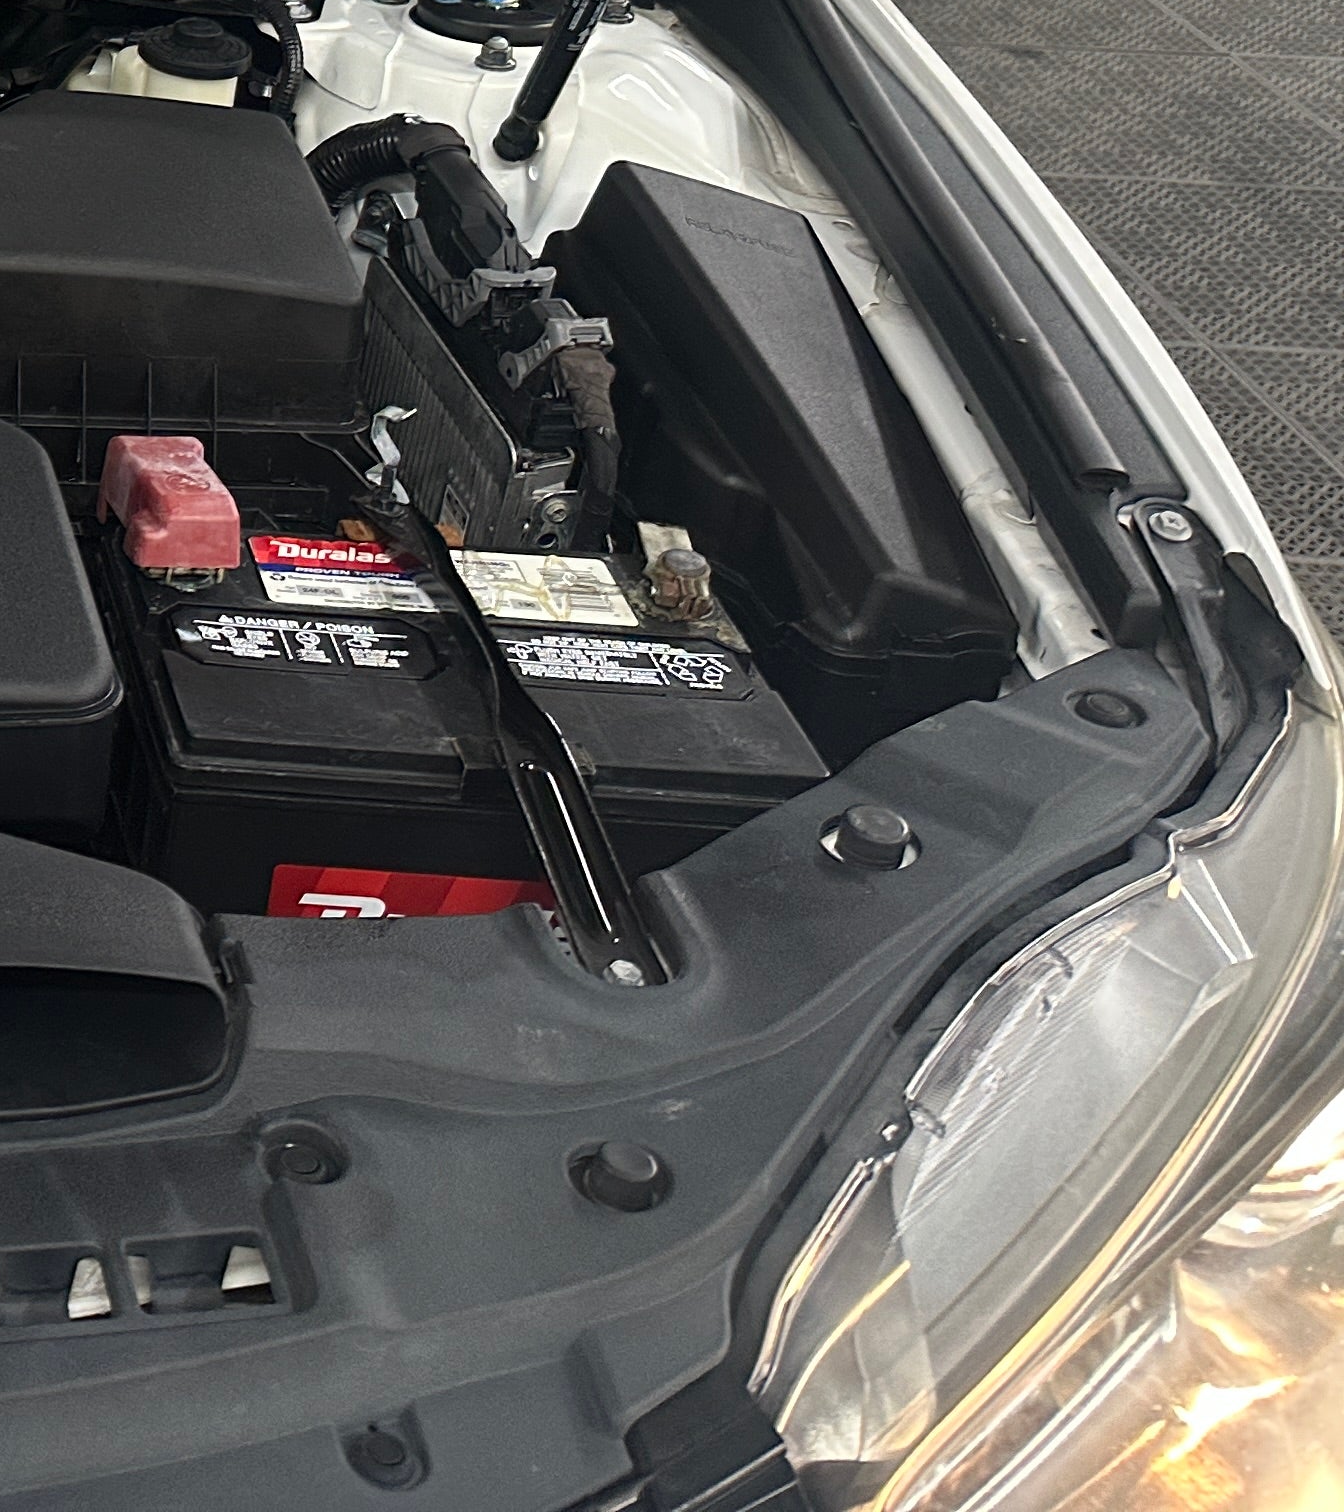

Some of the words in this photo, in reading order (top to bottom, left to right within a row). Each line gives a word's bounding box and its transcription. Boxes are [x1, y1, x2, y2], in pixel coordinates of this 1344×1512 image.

[270, 540, 392, 564] Duralas
[295, 566, 350, 576] PROVEN
[234, 616, 299, 629] DANGER
[316, 622, 375, 634] POISON
